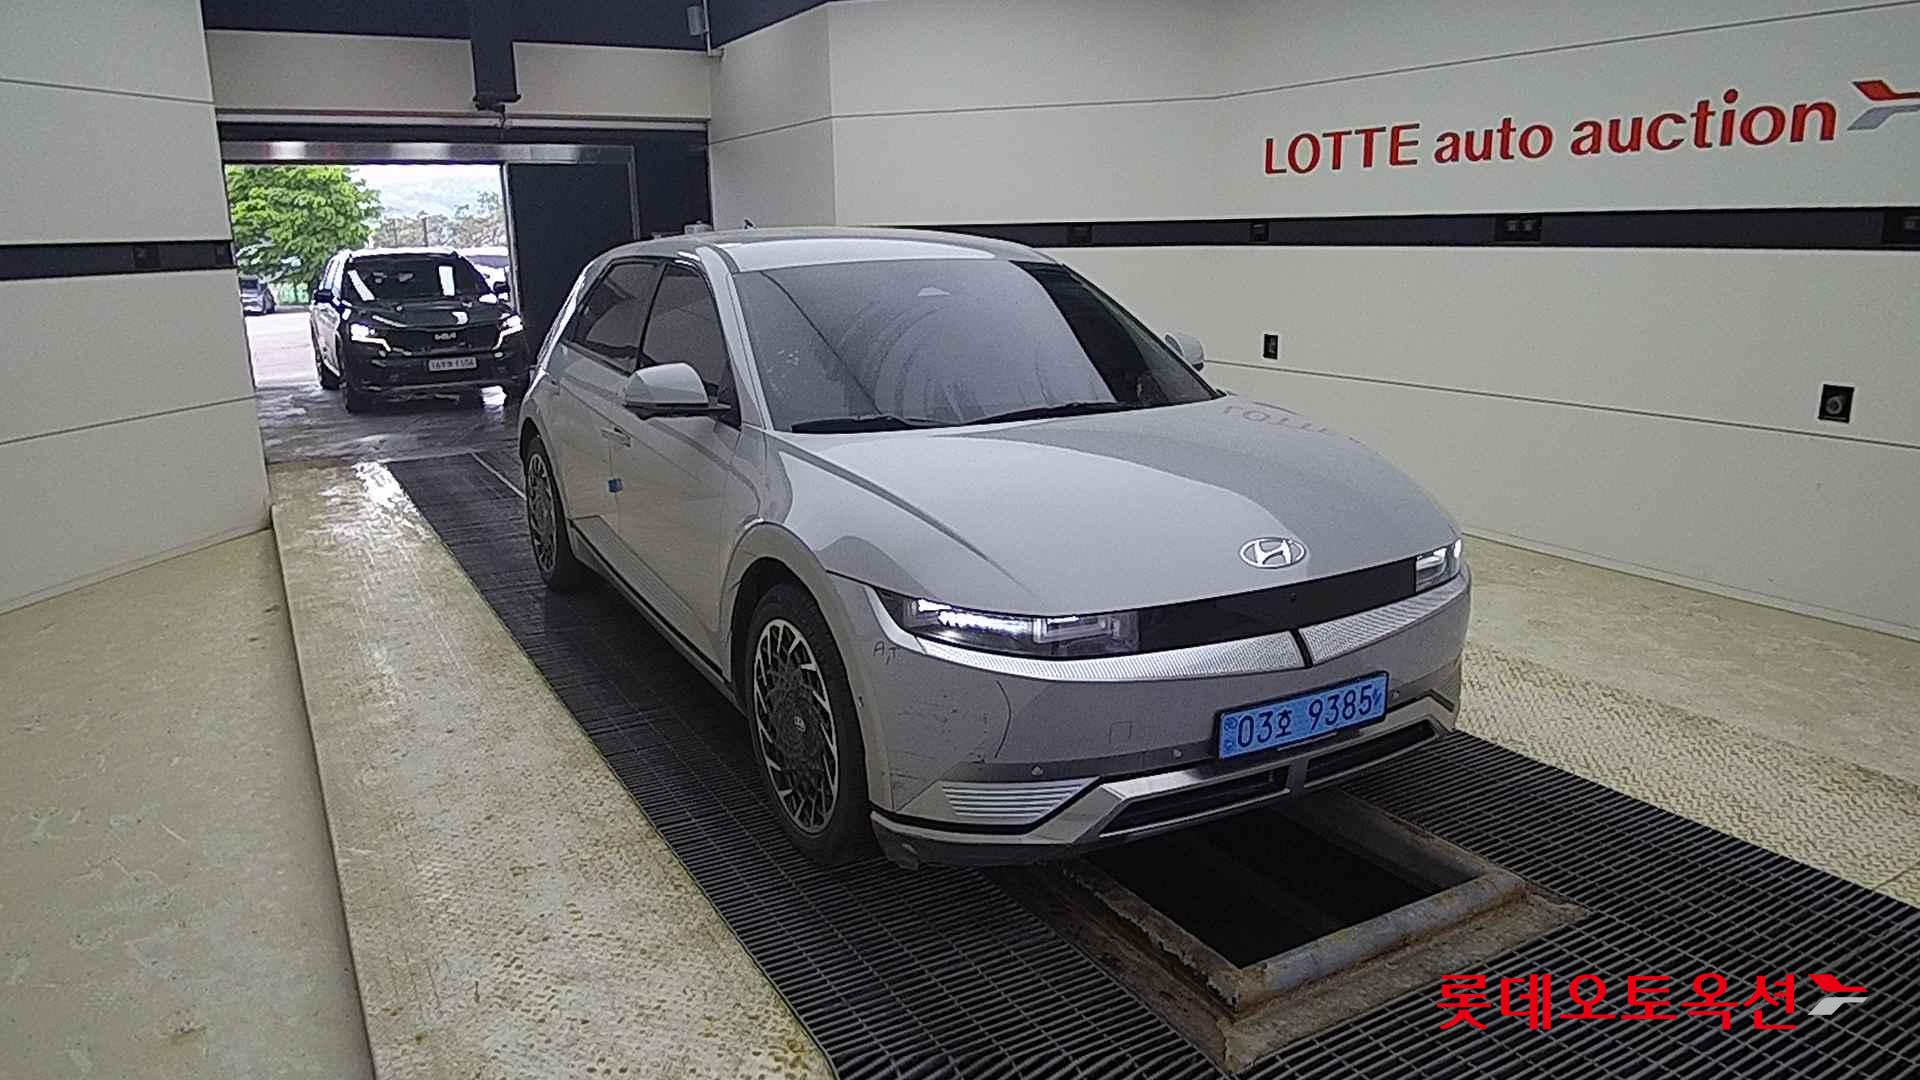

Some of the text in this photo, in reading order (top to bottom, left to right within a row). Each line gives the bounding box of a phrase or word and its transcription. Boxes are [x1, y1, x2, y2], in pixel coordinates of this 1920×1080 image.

[1264, 89, 1837, 175] LOTTE auto auction
[1237, 709, 1293, 748] 03호
[1308, 683, 1373, 731] 9385
